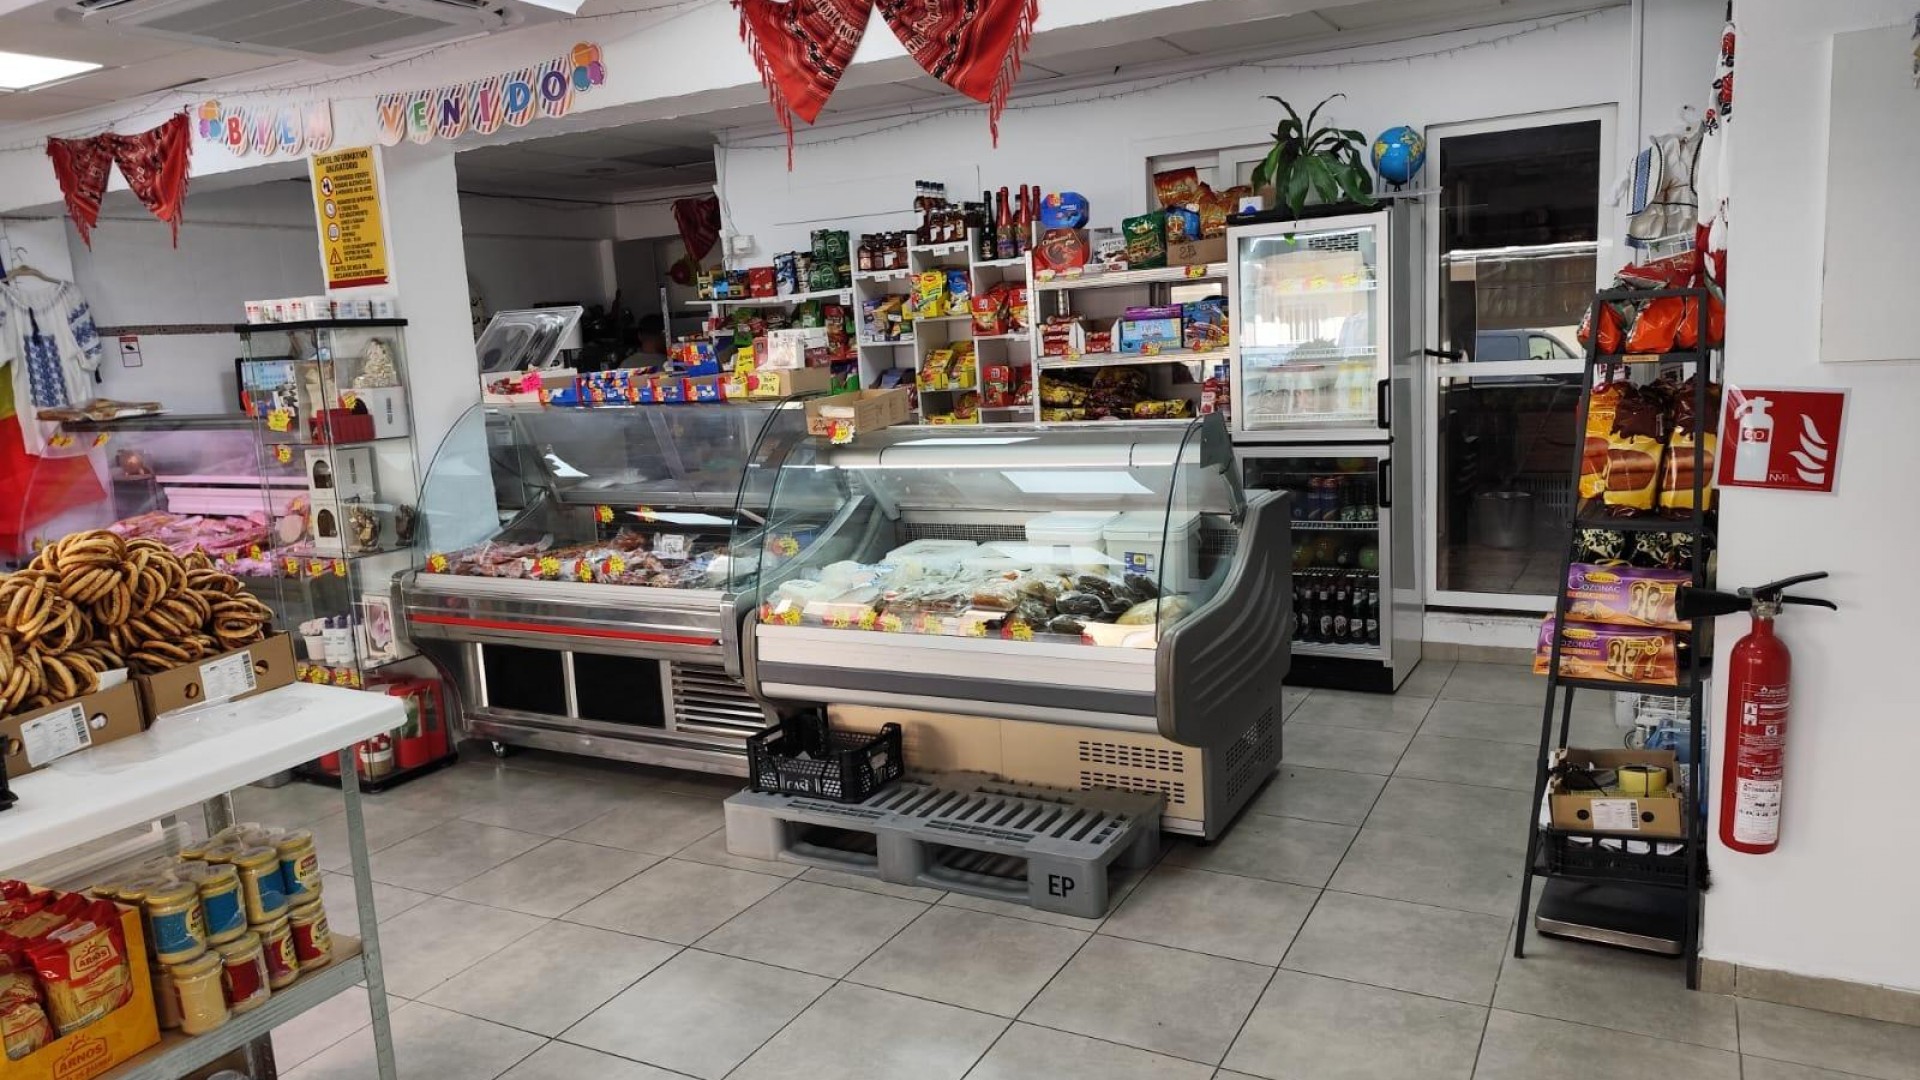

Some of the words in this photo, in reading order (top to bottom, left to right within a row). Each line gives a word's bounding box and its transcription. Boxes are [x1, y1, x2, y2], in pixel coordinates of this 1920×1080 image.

[227, 109, 326, 146] BIE
[381, 70, 567, 135] VENIDO
[1048, 874, 1075, 897] EP
[78, 949, 108, 969] ARNOS
[59, 1043, 103, 1074] ARNOS
